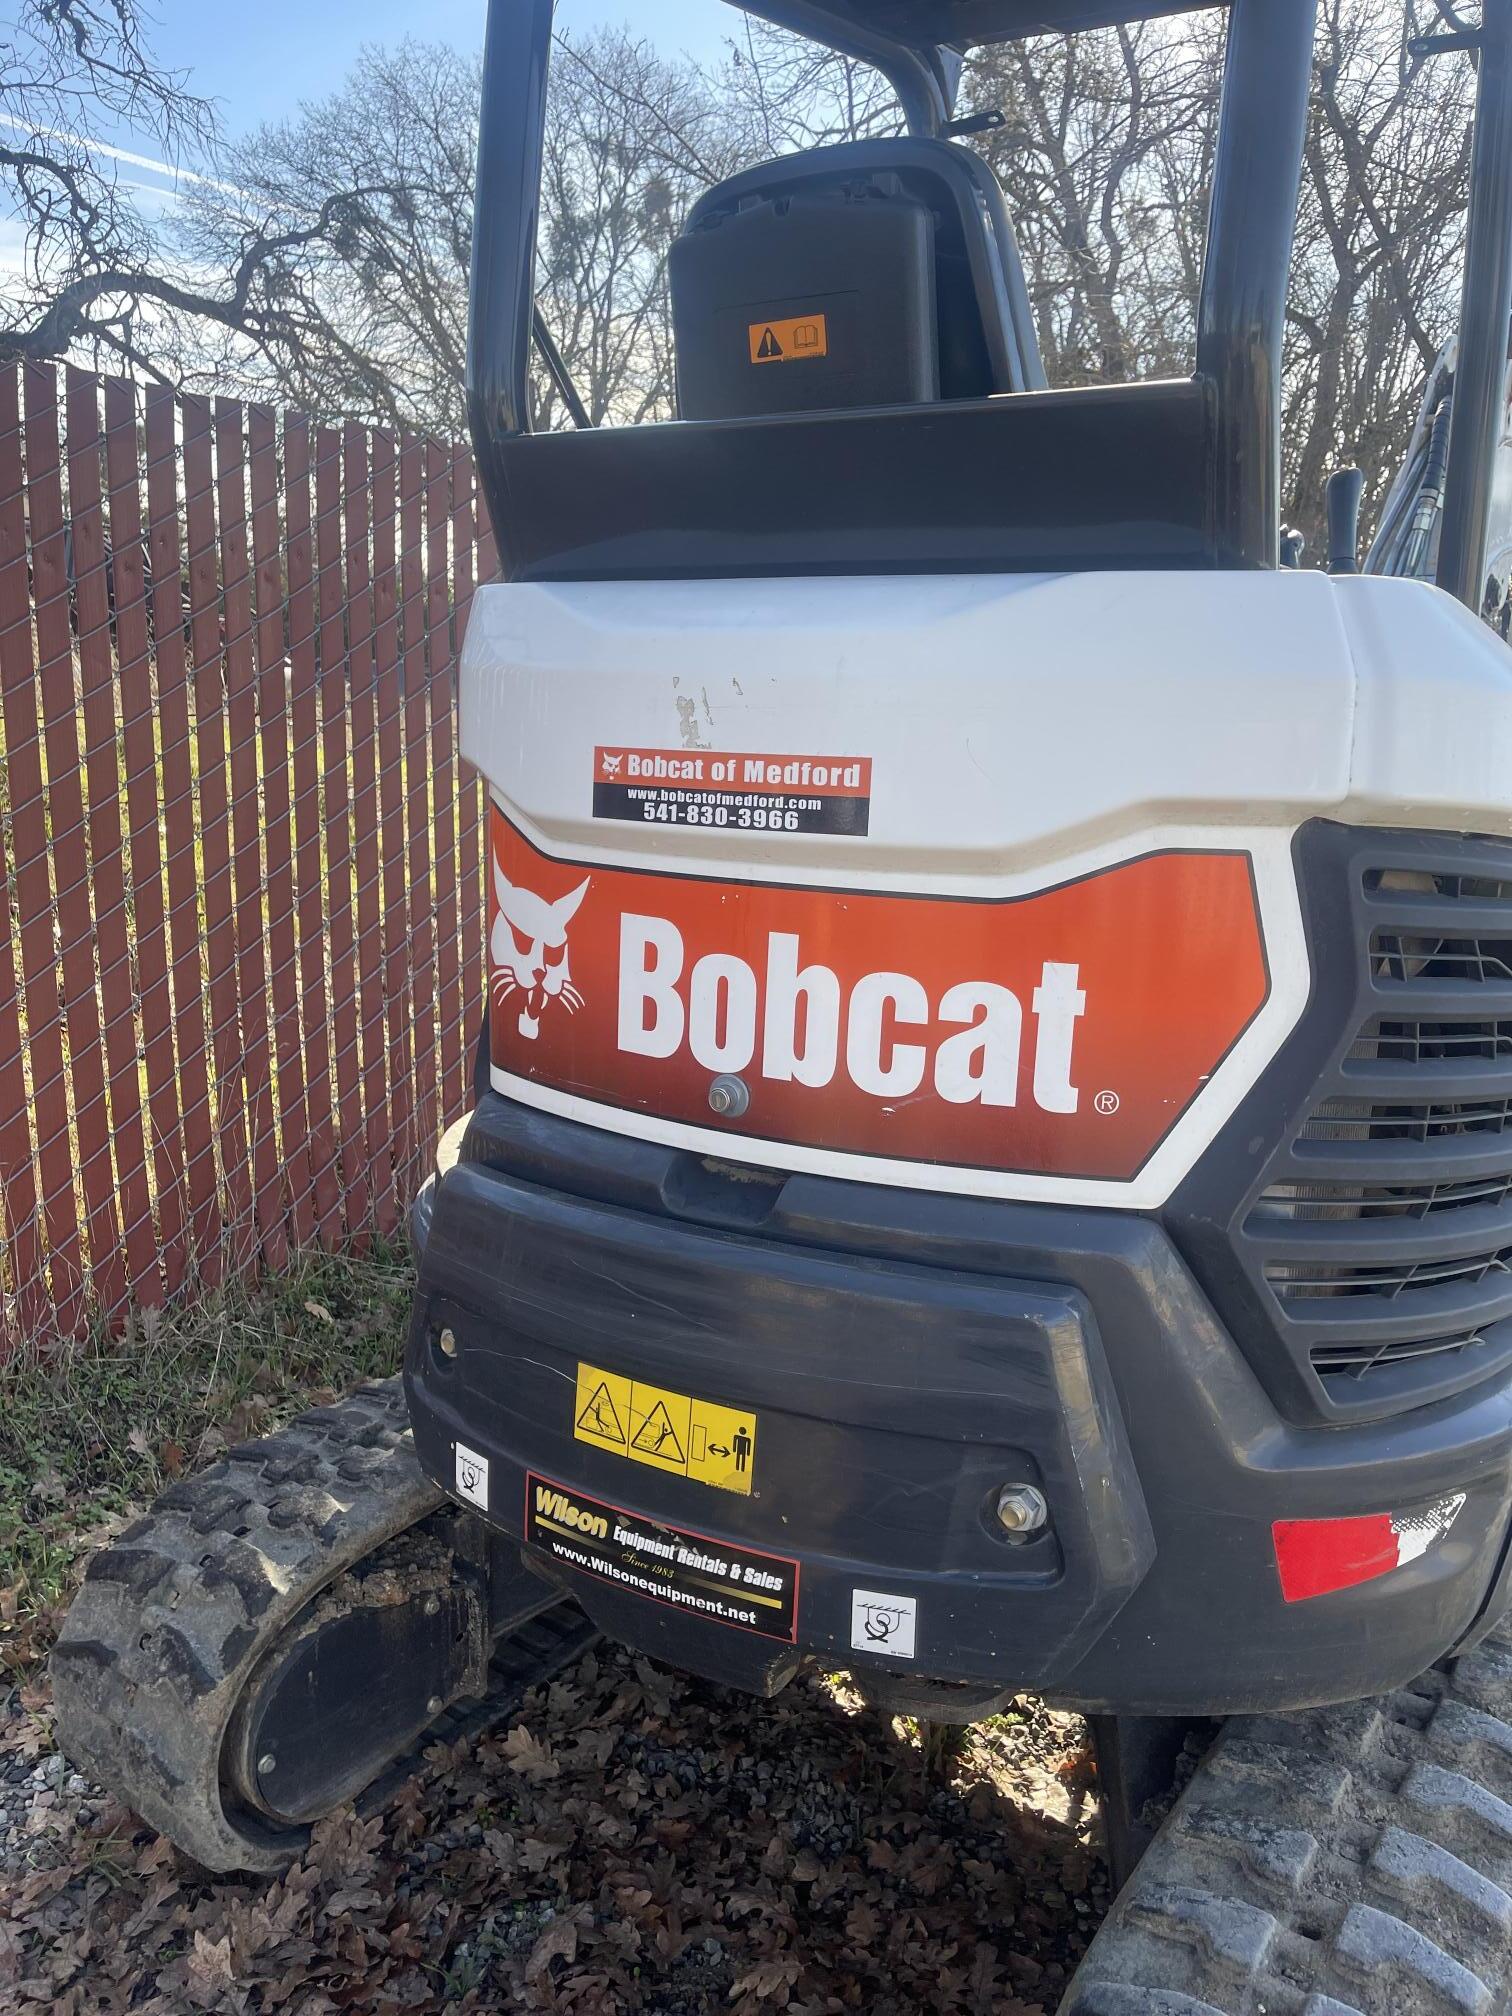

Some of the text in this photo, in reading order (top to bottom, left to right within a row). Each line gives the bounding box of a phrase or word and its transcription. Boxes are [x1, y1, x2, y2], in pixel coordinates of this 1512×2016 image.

[627, 754, 861, 787] Bobcat of Medford
[627, 788, 822, 810] www.bobcatofmedford.com
[643, 802, 799, 830] 541-830-3966
[617, 911, 1086, 1114] Bobcat
[536, 1486, 608, 1538] Wilson
[613, 1525, 783, 1591] Equipment Rentals & Sales
[621, 1550, 675, 1578] Since 1983
[552, 1541, 757, 1625] www.Wilsonequipment.net
